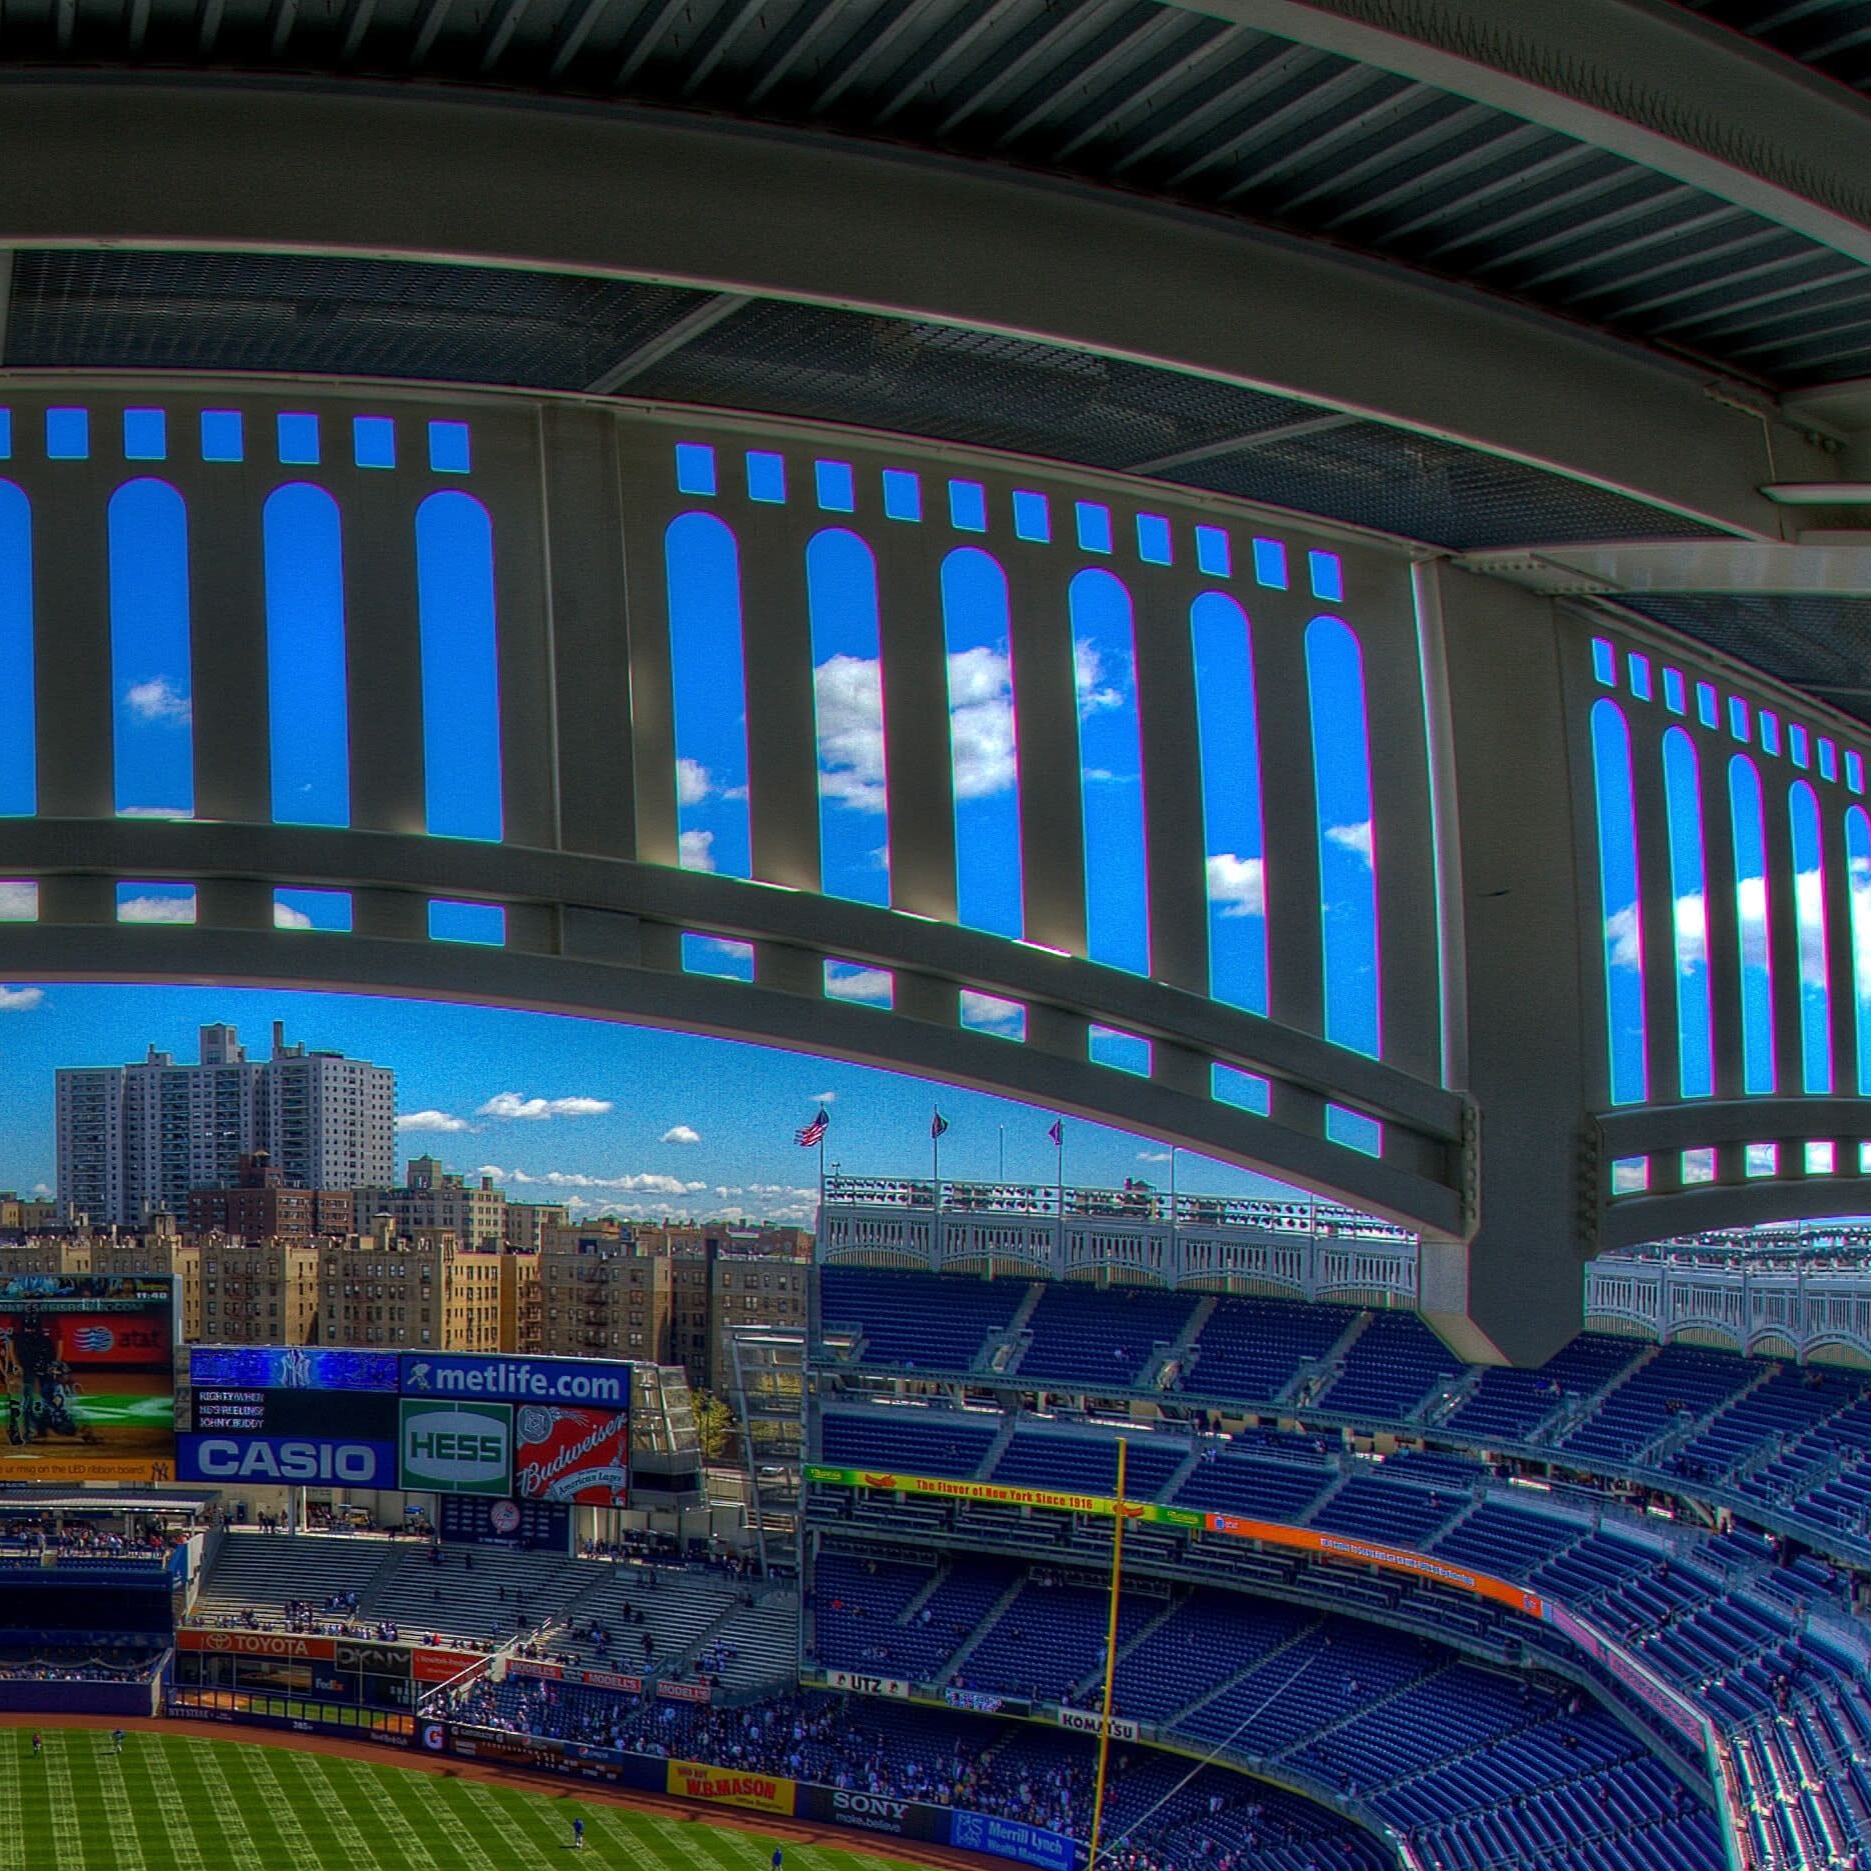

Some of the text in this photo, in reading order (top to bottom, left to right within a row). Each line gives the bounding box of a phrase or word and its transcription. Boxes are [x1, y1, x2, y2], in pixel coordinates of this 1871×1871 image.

[436, 1363, 620, 1400] metlife.com
[197, 1440, 376, 1481] CASIO
[411, 1432, 502, 1463] HESS
[516, 1411, 628, 1497] Budweiser
[916, 1479, 1093, 1510] The Flavor of New York Since 1916
[234, 1634, 310, 1656] TOYOTA
[337, 1647, 410, 1668] DKNY
[315, 1677, 345, 1692] FedEx
[849, 1674, 882, 1693] UTZ
[686, 1778, 777, 1801] W.B.MASON
[833, 1791, 910, 1820] SONY
[988, 1820, 1064, 1855] Merrill Lynch
